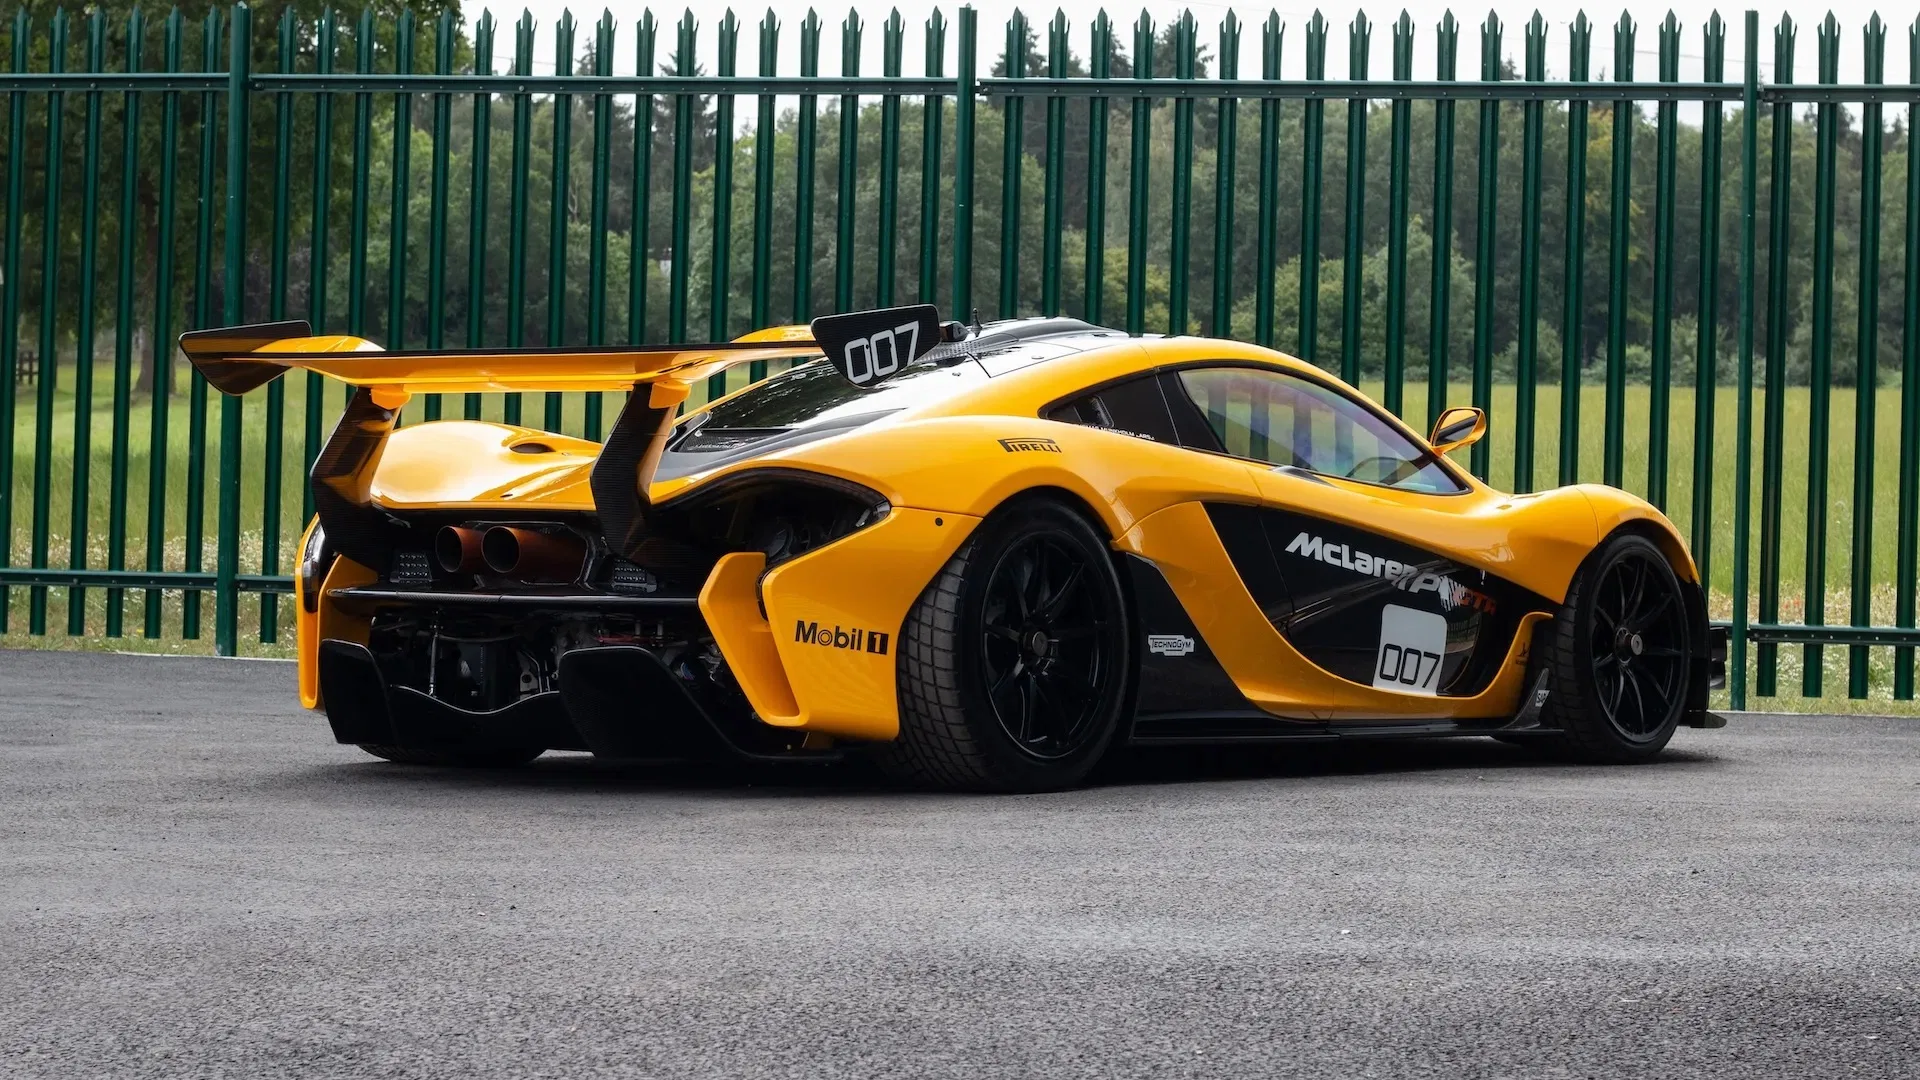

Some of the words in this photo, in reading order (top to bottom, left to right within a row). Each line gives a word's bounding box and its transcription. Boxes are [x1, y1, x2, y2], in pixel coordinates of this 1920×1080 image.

[844, 320, 919, 384] 007
[996, 437, 1062, 453] PIRELLI
[1285, 532, 1419, 592] McLaren
[795, 620, 863, 651] Mobil
[1379, 643, 1440, 688] 007
